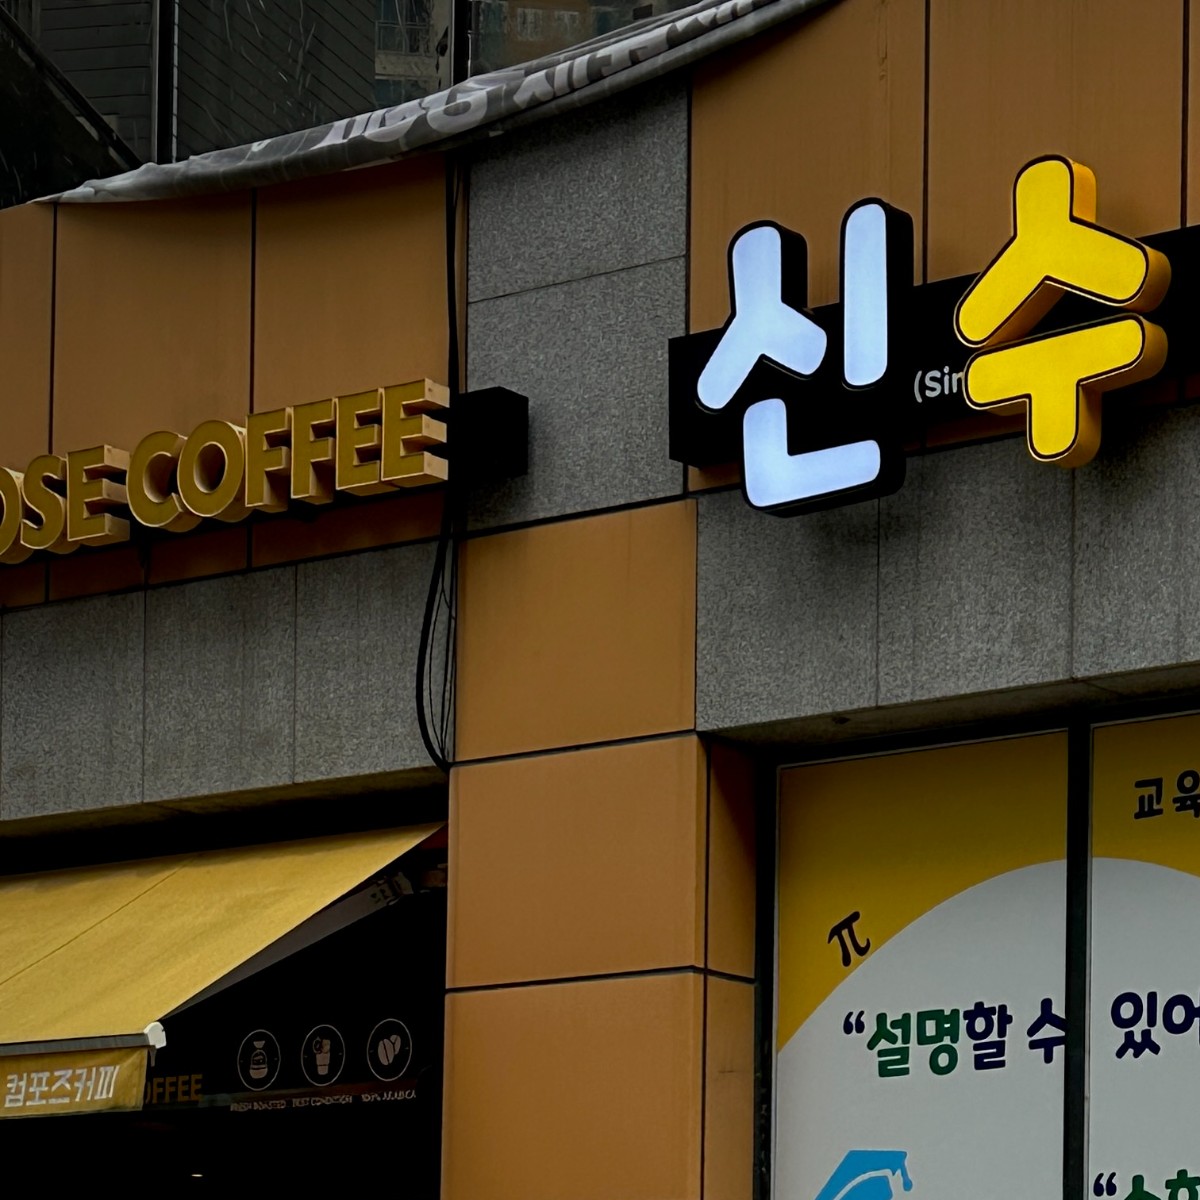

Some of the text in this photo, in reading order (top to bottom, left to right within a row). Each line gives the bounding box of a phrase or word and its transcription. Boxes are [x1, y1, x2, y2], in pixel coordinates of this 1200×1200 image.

[127, 378, 450, 532] COFFEE
[1026, 998, 1067, 1063] 수
[4, 1064, 121, 1107] 컴포즈커피
[145, 1073, 203, 1104] FFEE
